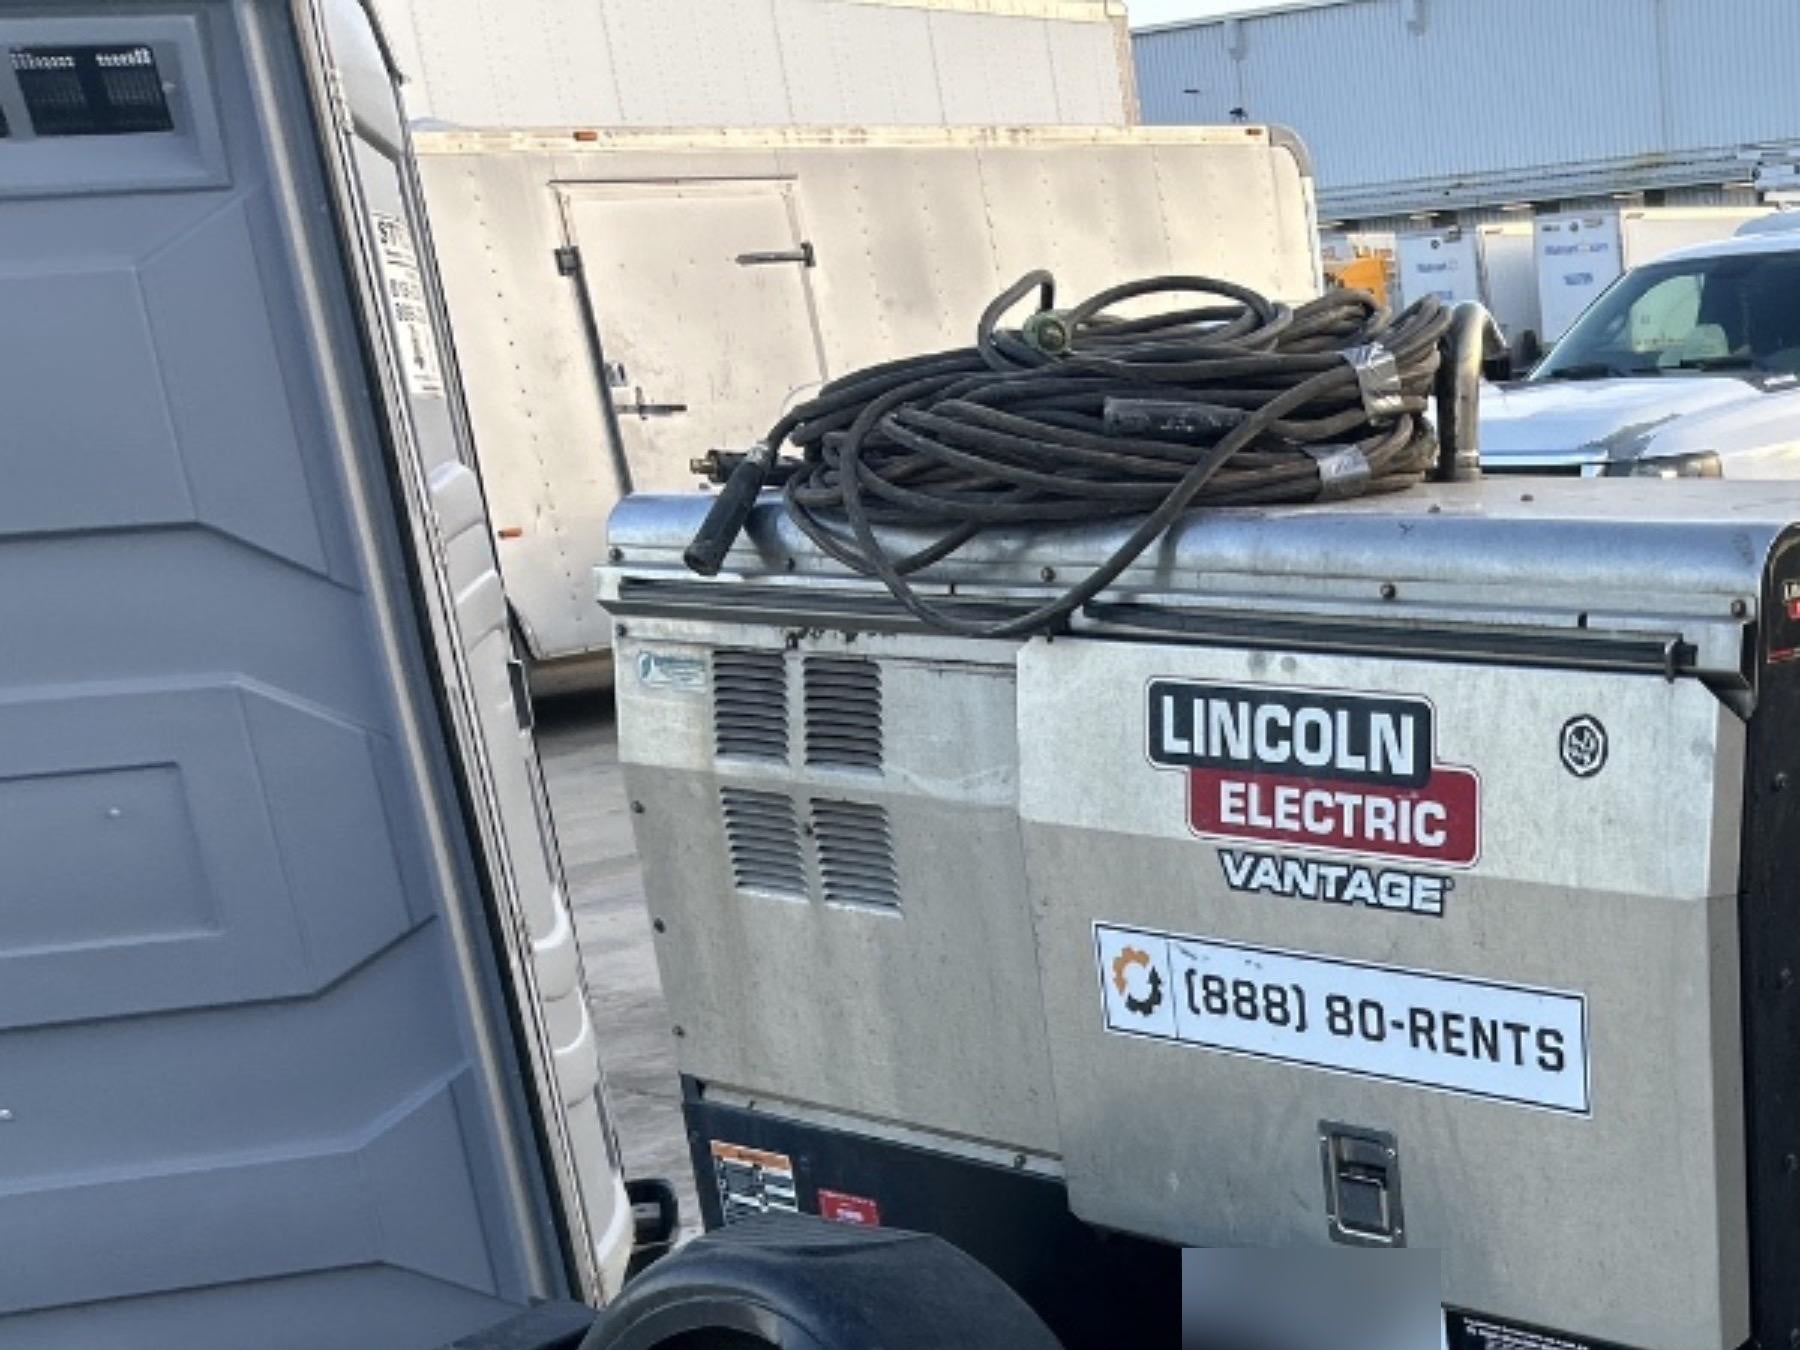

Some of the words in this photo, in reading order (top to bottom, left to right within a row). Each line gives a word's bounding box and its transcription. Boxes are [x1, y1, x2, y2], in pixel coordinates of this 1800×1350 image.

[1160, 694, 1415, 777] LINCOLN
[1219, 781, 1448, 848] ELECTRIC
[1219, 849, 1446, 917] VANTAGE
[1184, 967, 1309, 1033] (888)
[1324, 993, 1567, 1074] 80-RENTS
